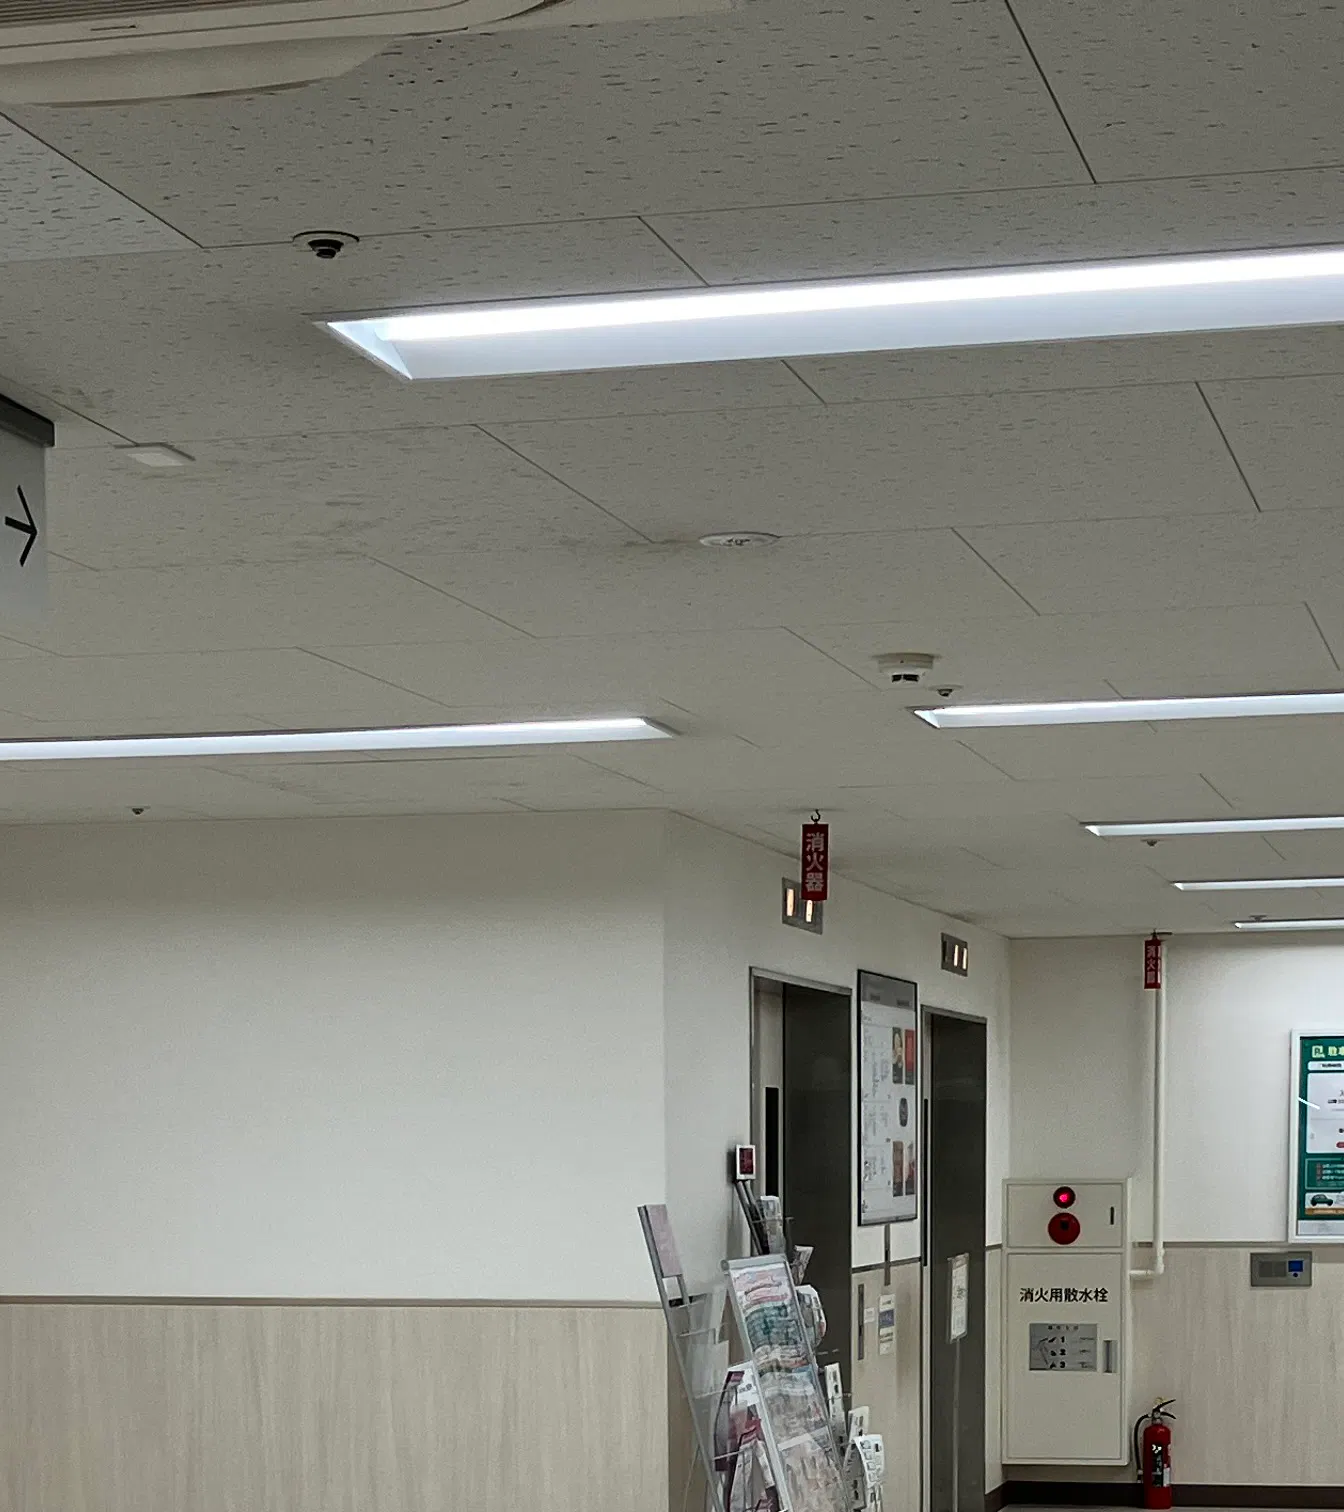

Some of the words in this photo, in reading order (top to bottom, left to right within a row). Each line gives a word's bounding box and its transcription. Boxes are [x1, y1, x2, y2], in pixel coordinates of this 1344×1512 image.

[806, 832, 824, 892] 消火器
[1019, 1287, 1109, 1303] 消火用散水栓
